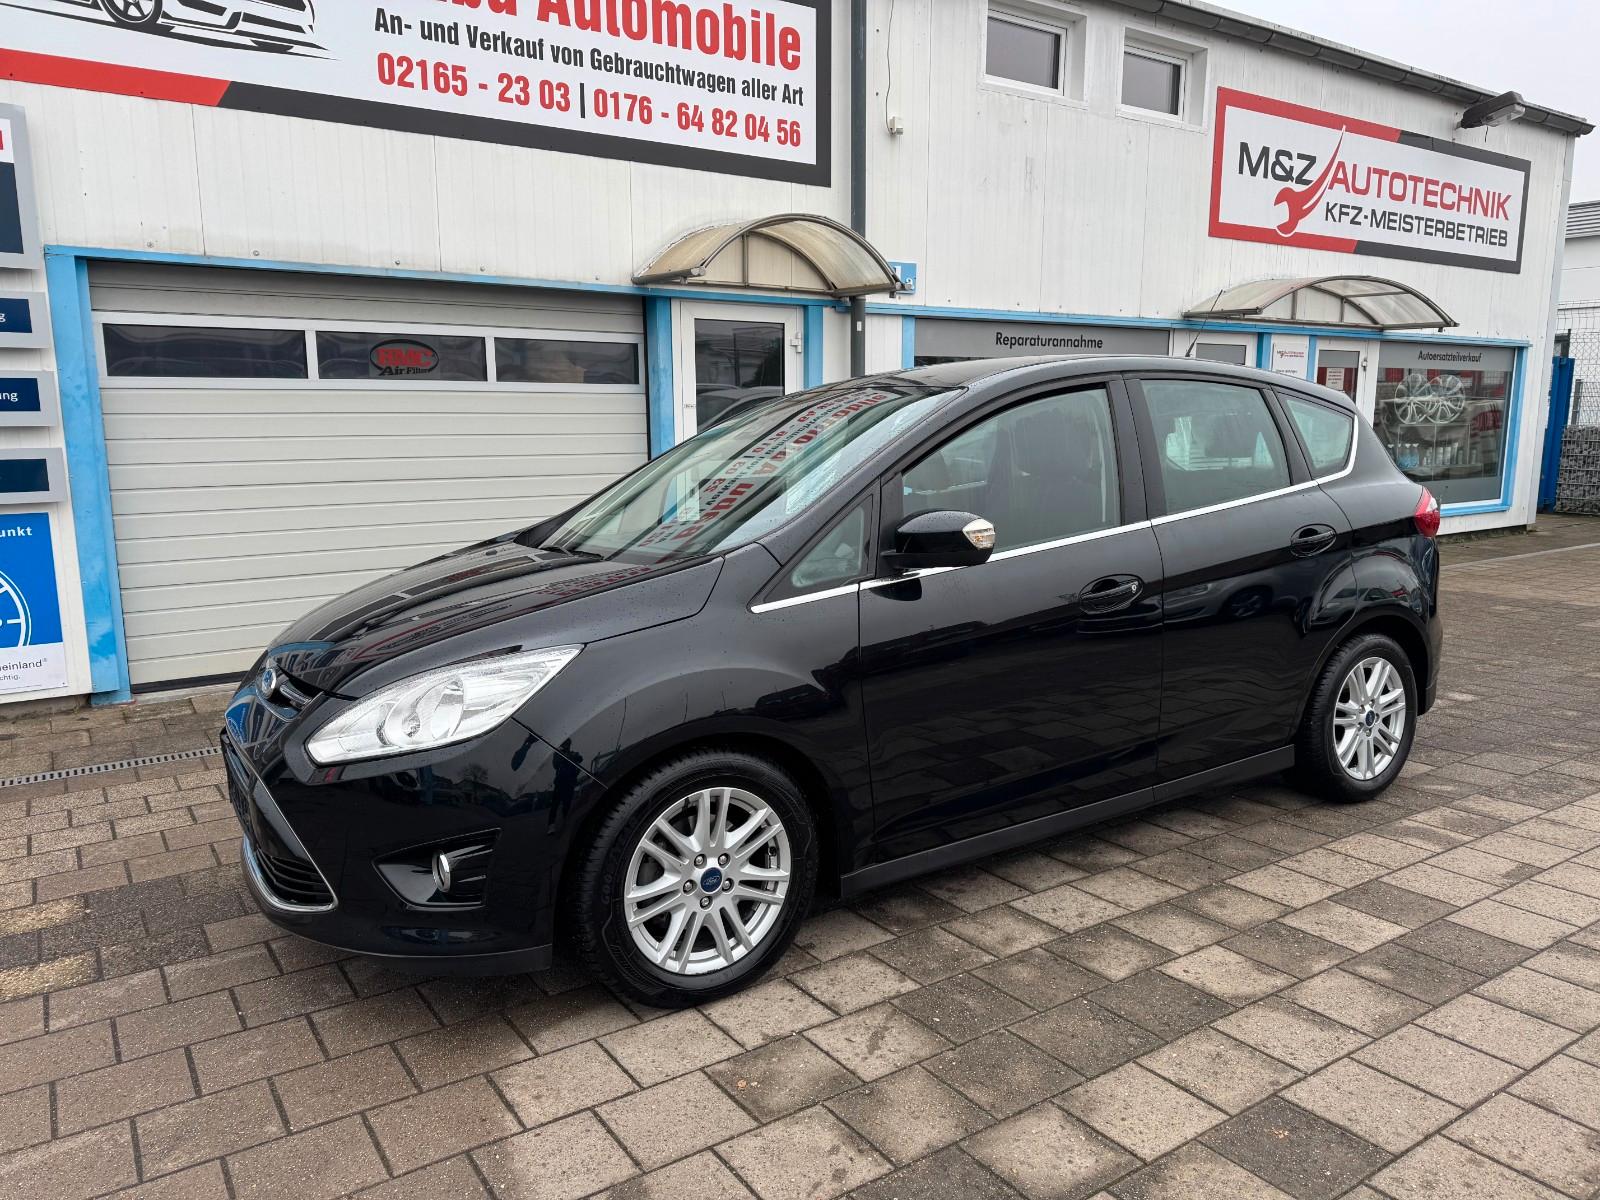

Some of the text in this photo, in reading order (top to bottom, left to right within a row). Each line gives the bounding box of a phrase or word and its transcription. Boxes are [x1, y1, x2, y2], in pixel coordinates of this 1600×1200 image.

[374, 7, 412, 36] An-
[419, 19, 460, 46] und
[465, 23, 545, 62] Verkauf
[549, 44, 584, 68] von
[589, 47, 736, 95] Gebrauchtwagen
[741, 77, 778, 102] aller
[781, 83, 804, 107] Art
[376, 51, 469, 97] 02165
[497, 72, 531, 107] 23
[538, 79, 571, 113] 03
[593, 88, 653, 126] 0176
[676, 102, 705, 133] 64
[711, 107, 738, 138] 82
[744, 112, 771, 143] 04
[776, 118, 801, 148] 56
[1238, 141, 1317, 187] M&Z
[1327, 160, 1512, 221] AUTOTECHNIK
[995, 331, 1104, 350] Reparaturannahme
[1417, 349, 1483, 363] Autoersatzteilverkauf
[379, 366, 405, 376] Air
[0, 392, 19, 403] ng
[0, 658, 43, 672] einland
